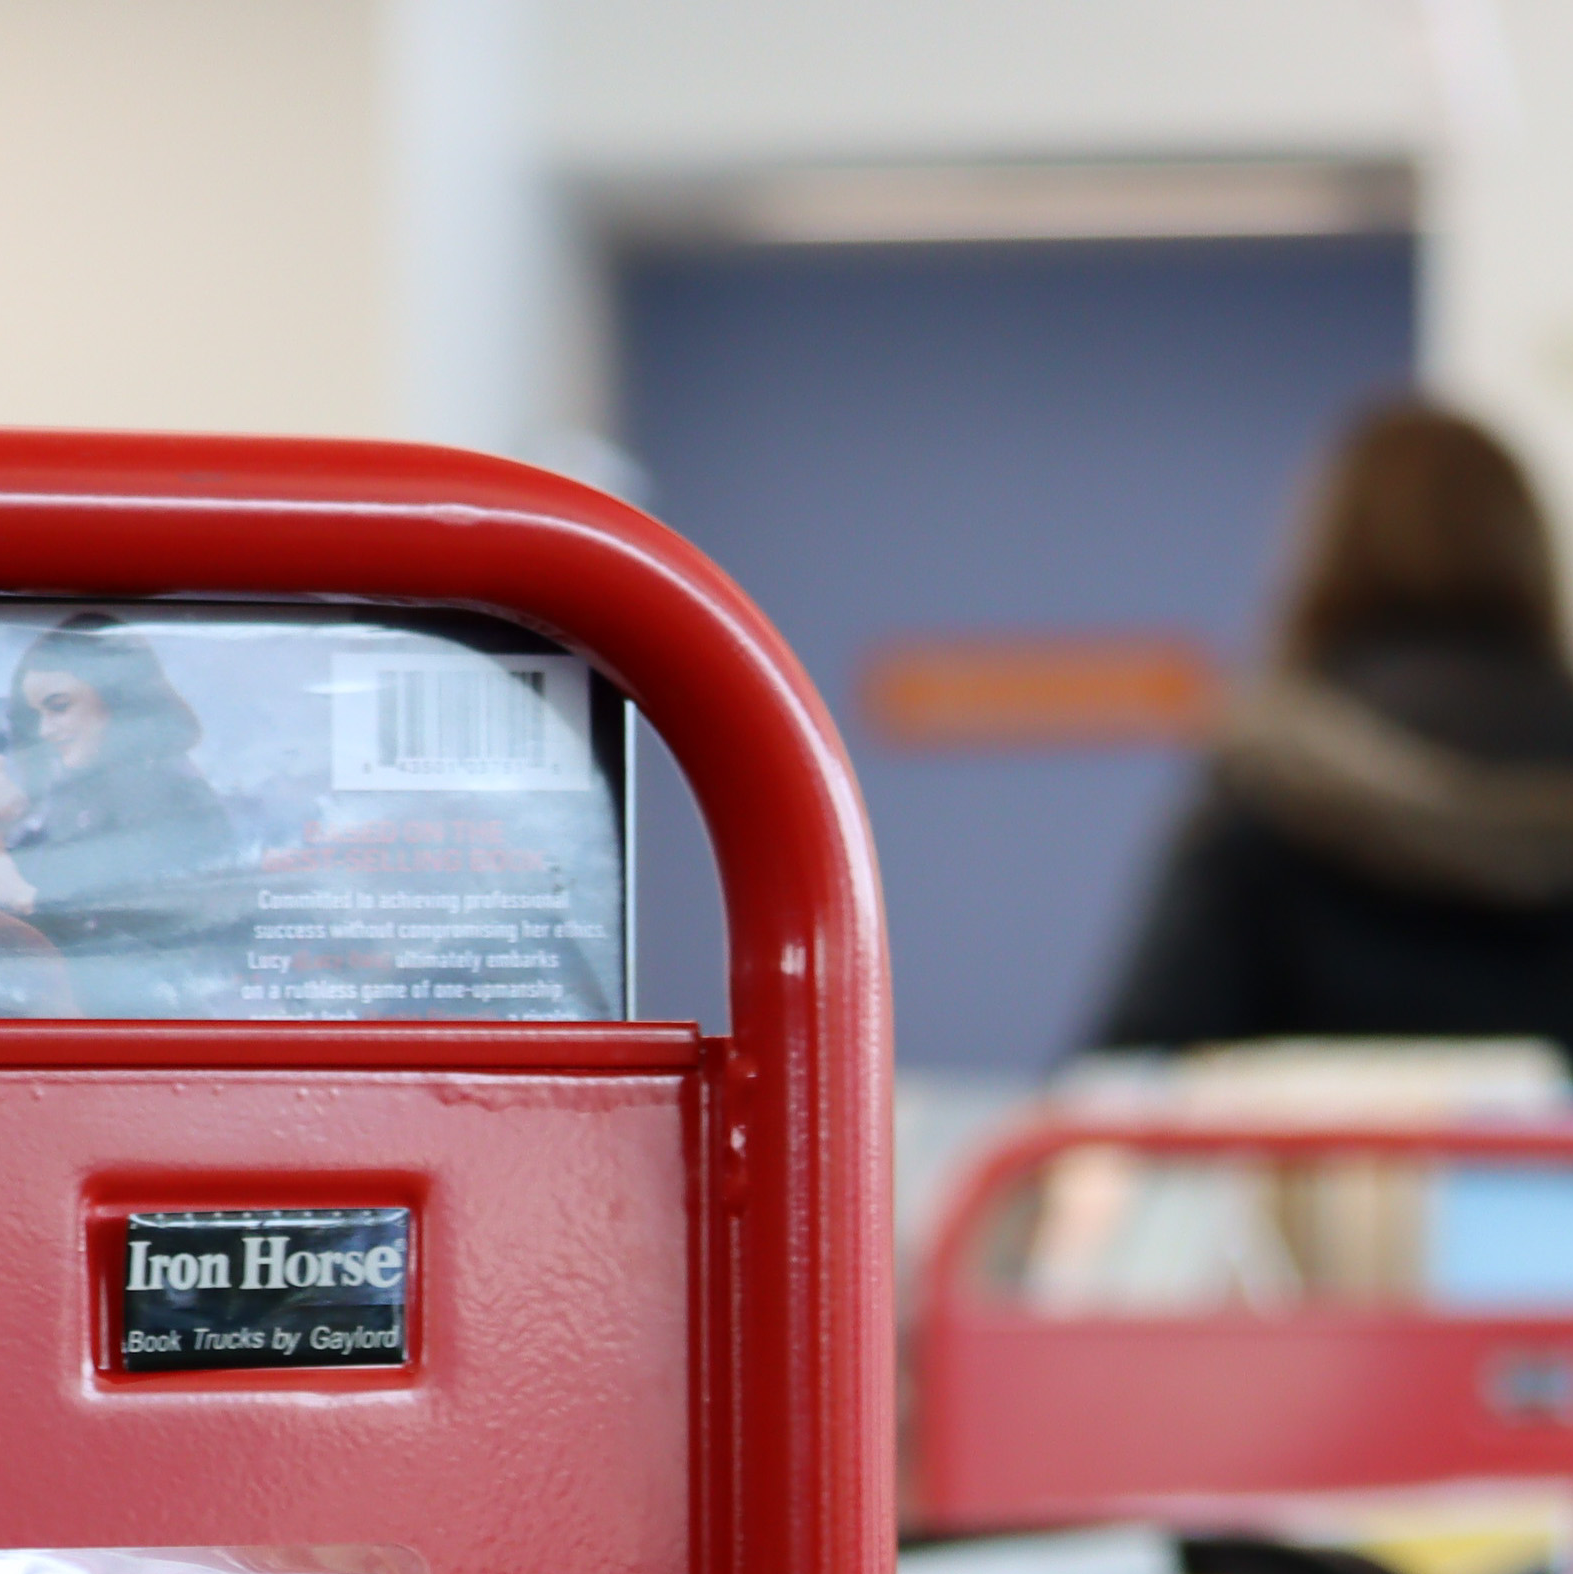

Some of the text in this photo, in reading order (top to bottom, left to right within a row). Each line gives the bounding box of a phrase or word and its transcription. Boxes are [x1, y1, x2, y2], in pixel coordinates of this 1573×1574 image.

[303, 820, 507, 844] BASED ON THE
[261, 847, 546, 872] BEST-SELLING BOOK
[258, 889, 571, 914] Committed to achieving professional
[253, 924, 326, 940] success
[329, 921, 396, 940] without
[398, 922, 518, 943] compromising
[521, 920, 551, 939] her
[247, 951, 292, 974] Lucy
[394, 950, 482, 974] ultimately
[485, 950, 560, 969] embarks
[240, 985, 266, 1000] on
[284, 980, 359, 1000] ruthless
[360, 985, 409, 1004] game
[410, 979, 431, 999] of
[433, 979, 565, 1004] one-upmanship
[125, 1236, 405, 1291] Iron Horse
[126, 1324, 401, 1356] Book Trucks by Gaylord
